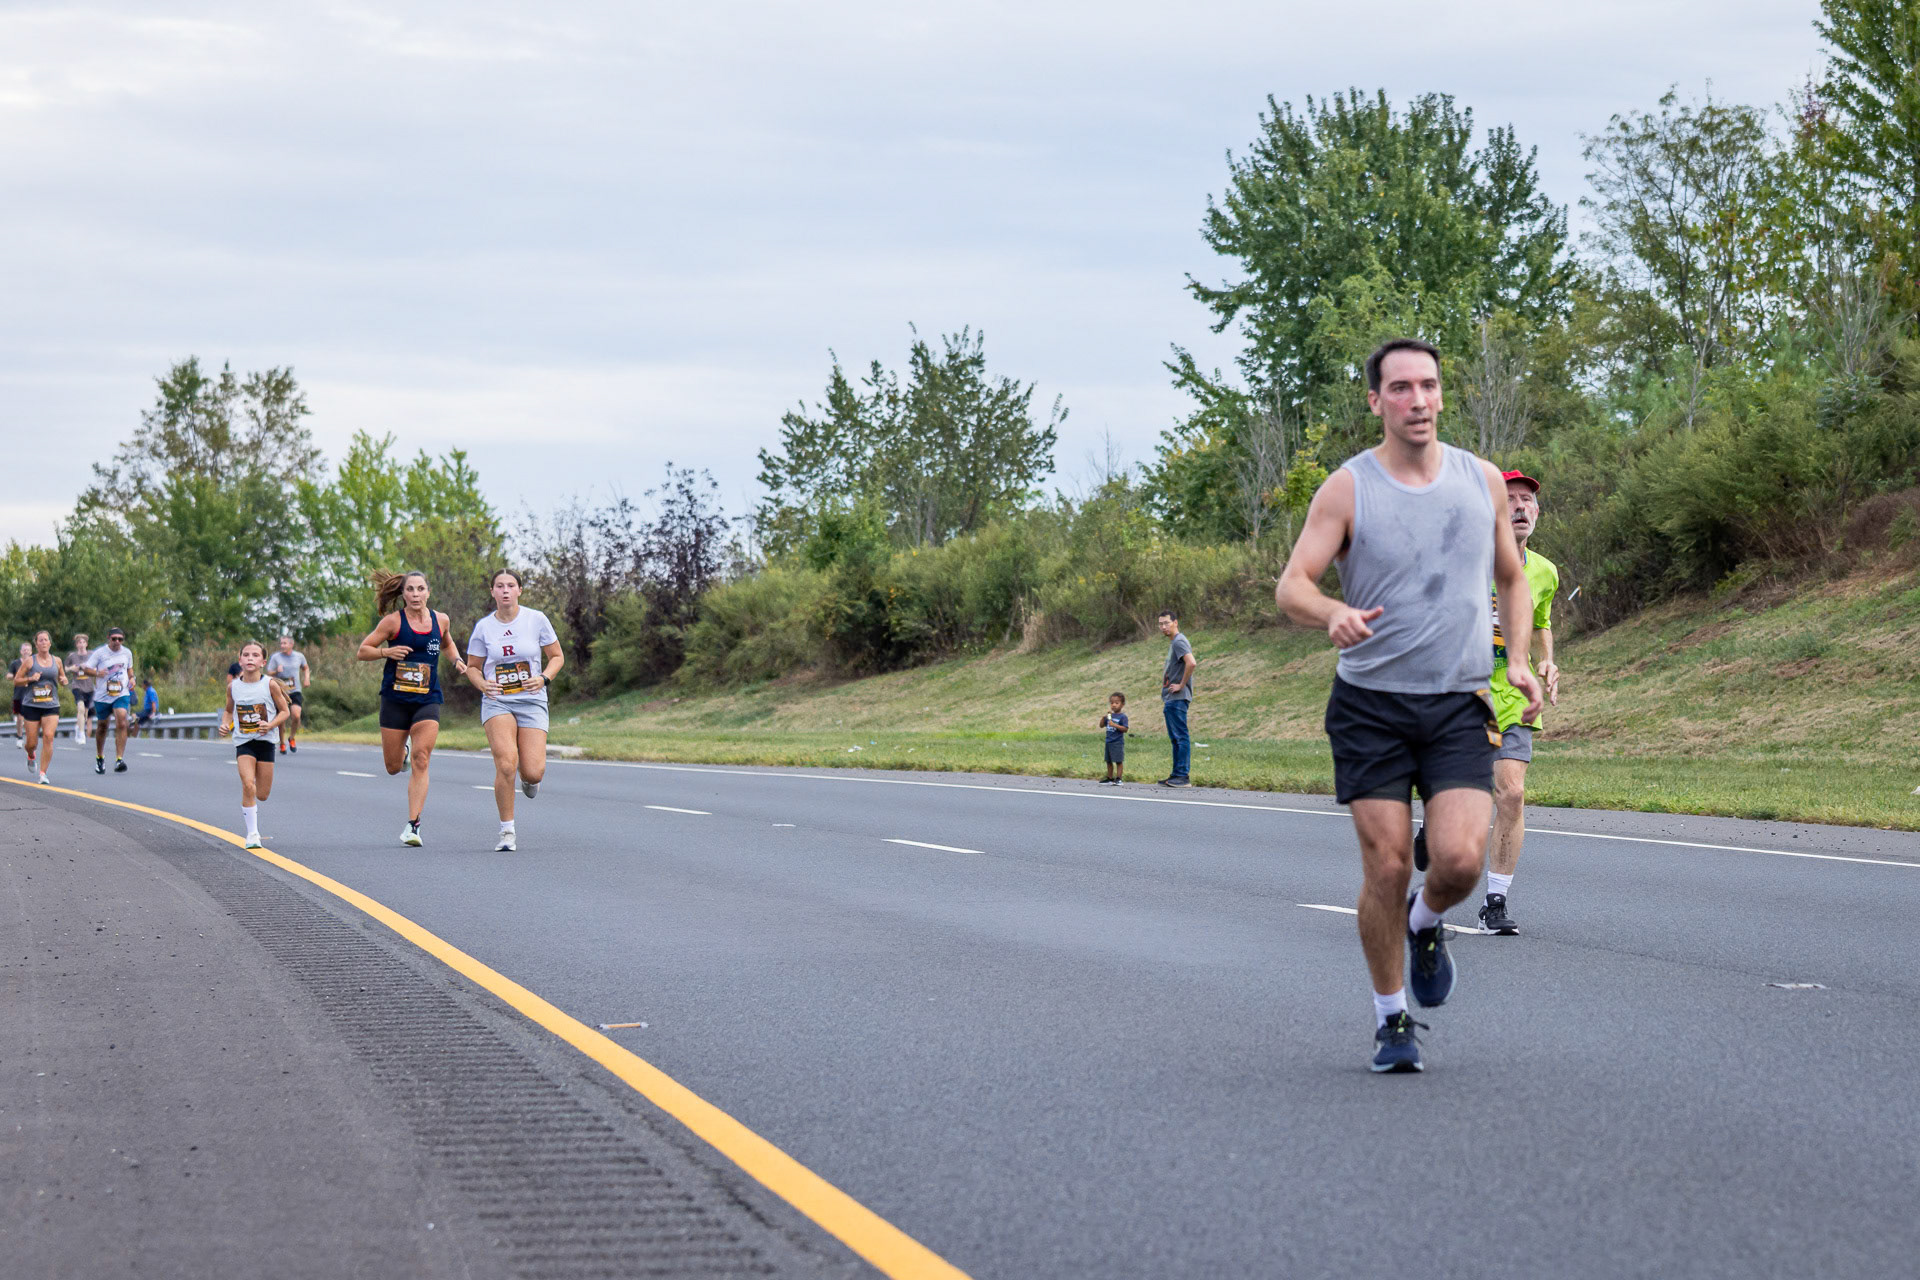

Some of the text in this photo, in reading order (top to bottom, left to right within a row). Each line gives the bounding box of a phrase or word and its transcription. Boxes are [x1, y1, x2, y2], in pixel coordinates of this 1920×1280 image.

[502, 645, 515, 656] R
[402, 671, 424, 682] 43
[498, 670, 529, 684] 296
[242, 713, 261, 723] 42
